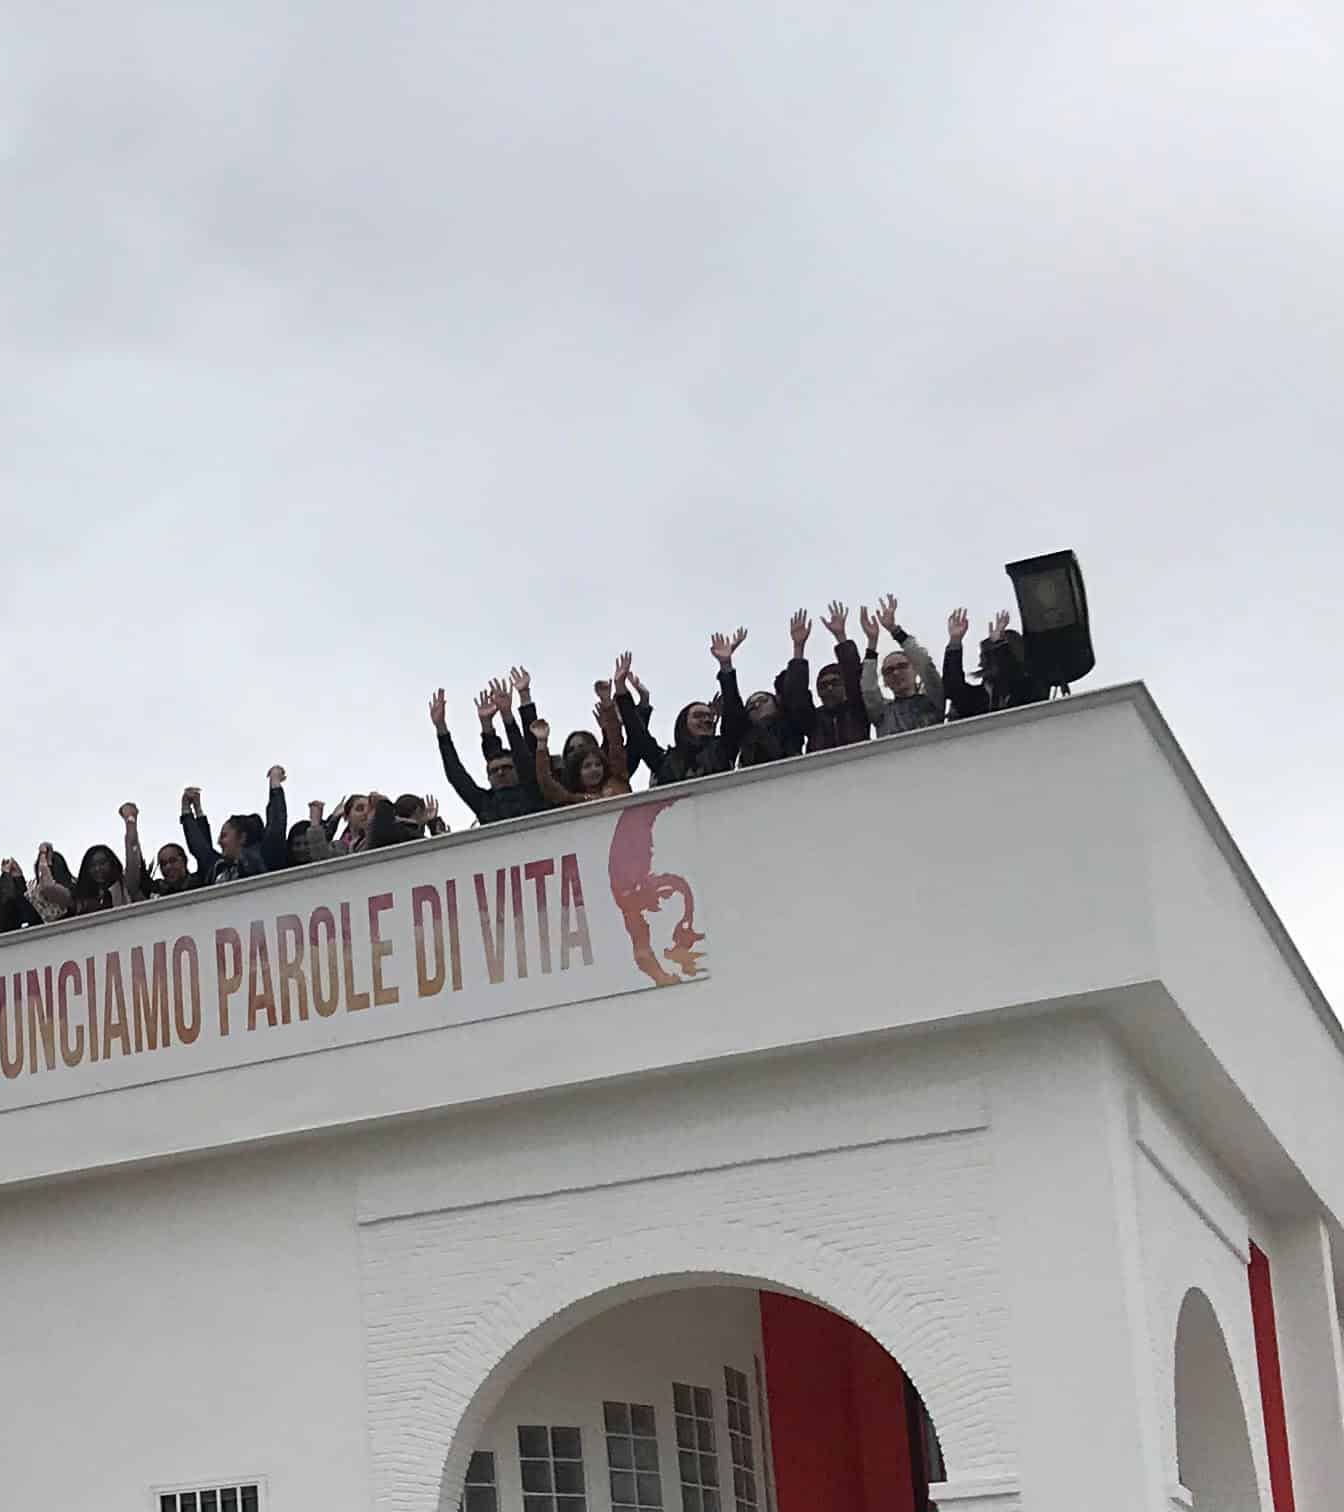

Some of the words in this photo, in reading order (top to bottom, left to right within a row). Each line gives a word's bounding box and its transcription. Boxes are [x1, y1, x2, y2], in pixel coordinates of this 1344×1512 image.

[215, 892, 400, 1037] PAROLE
[413, 879, 463, 998] DI
[474, 852, 593, 984] VITA
